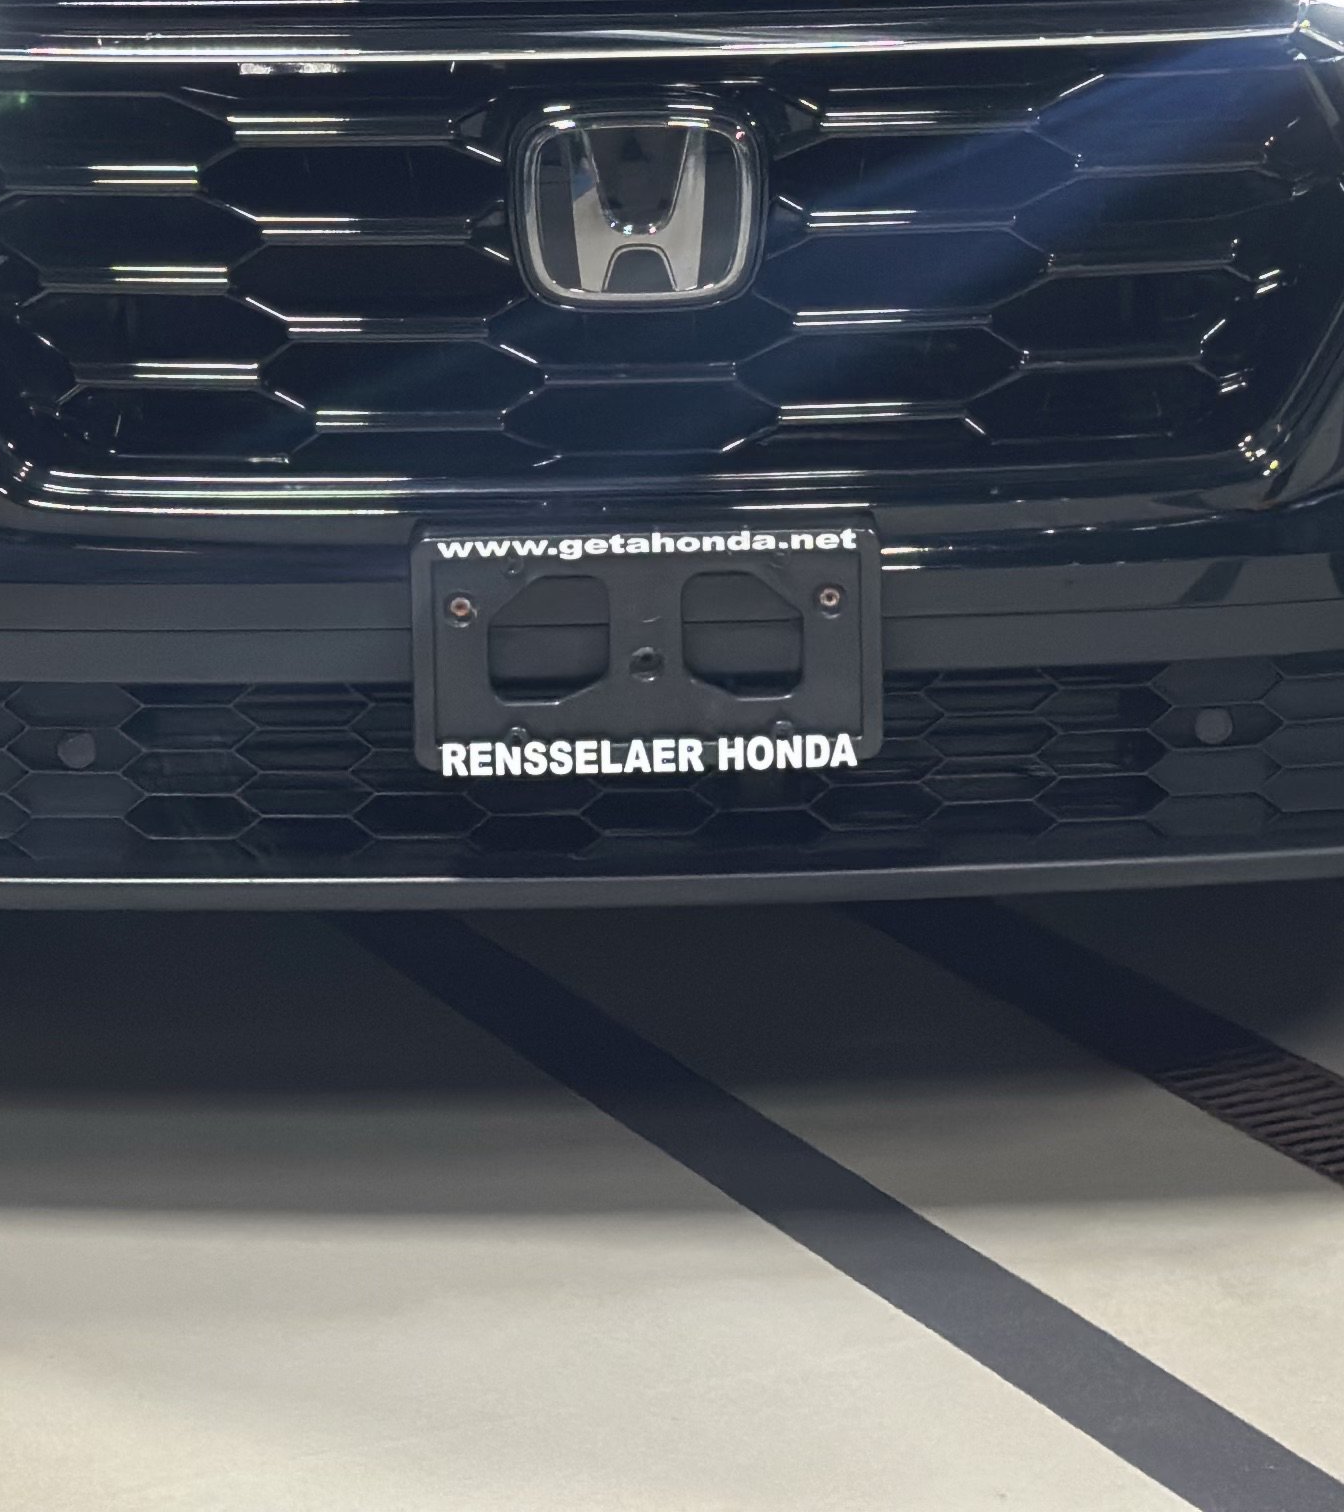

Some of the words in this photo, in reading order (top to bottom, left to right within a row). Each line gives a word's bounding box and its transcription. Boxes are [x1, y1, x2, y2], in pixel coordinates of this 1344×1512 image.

[436, 528, 858, 561] www.getahonda.net
[441, 738, 706, 777] RENSSELAER
[717, 733, 859, 771] HONDA
